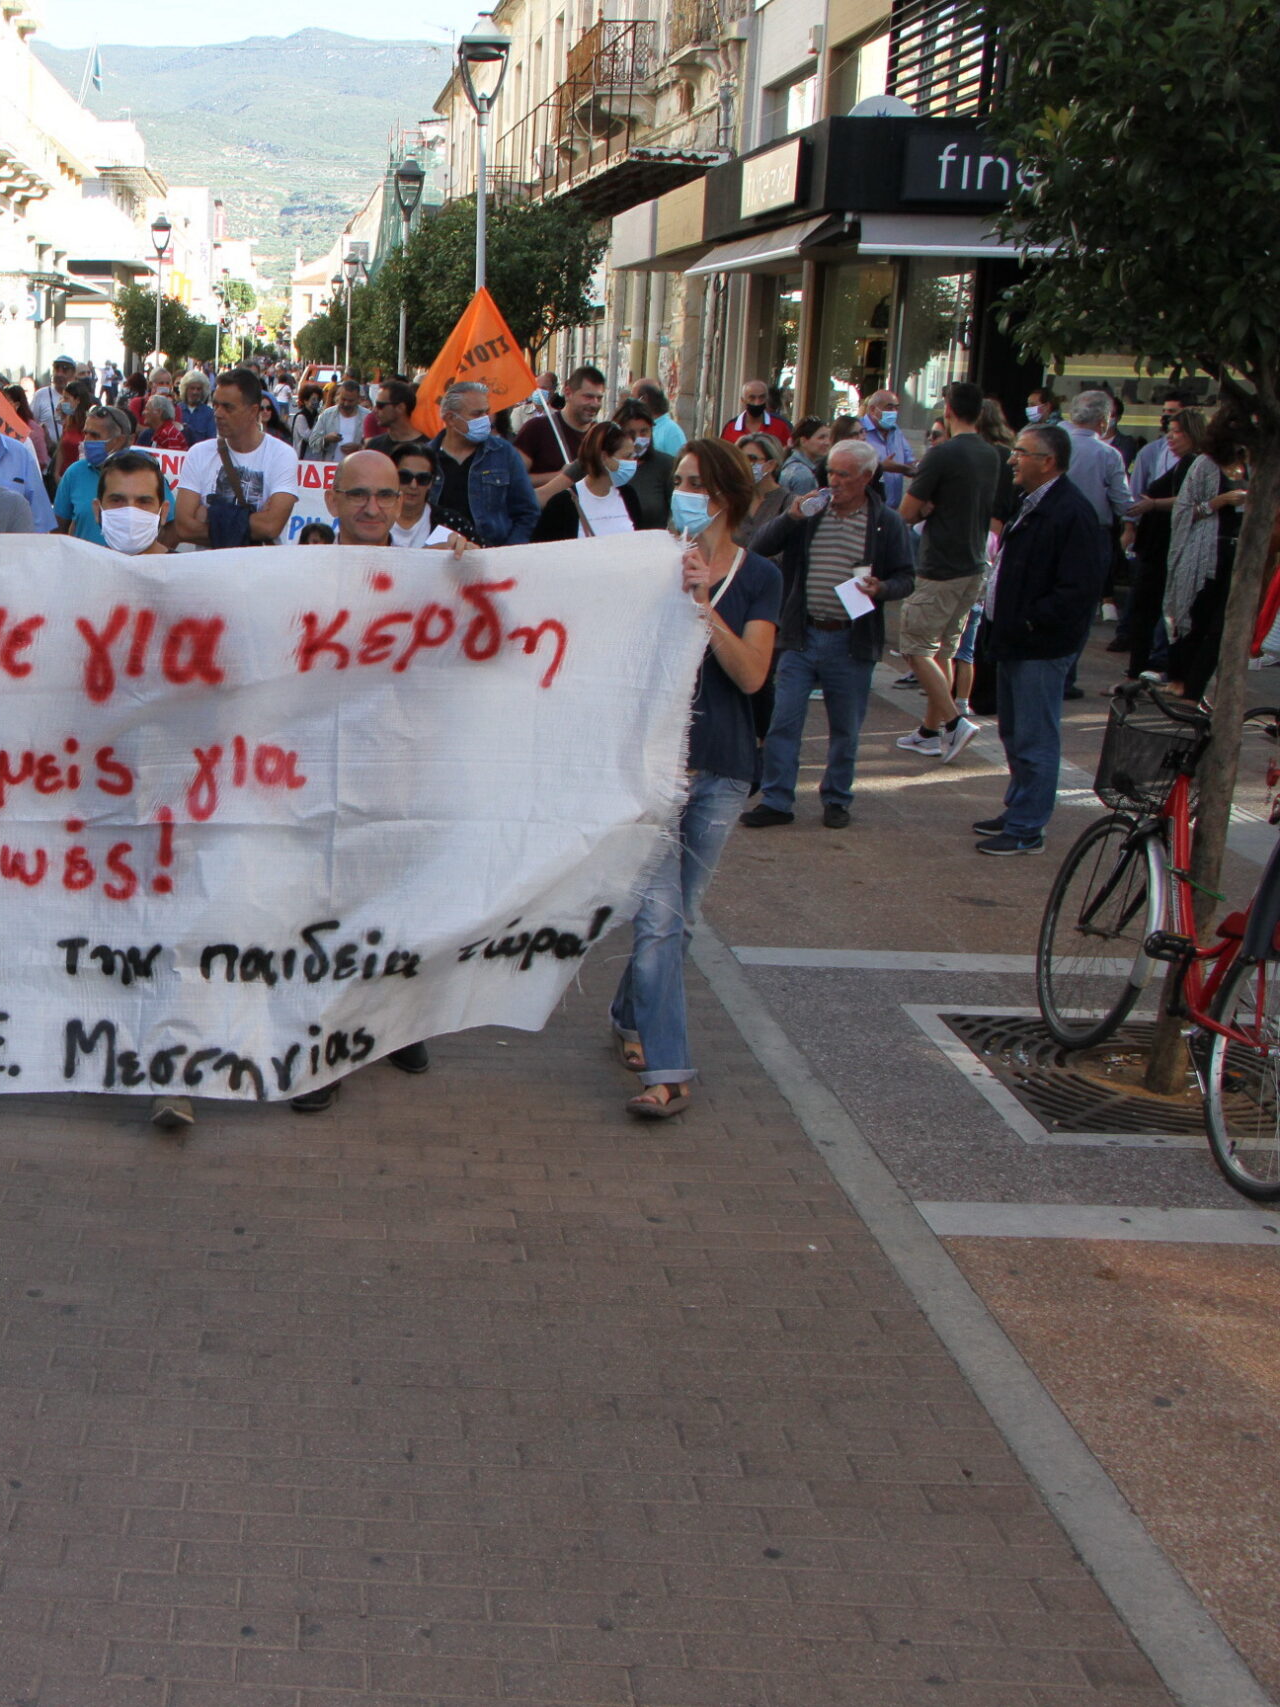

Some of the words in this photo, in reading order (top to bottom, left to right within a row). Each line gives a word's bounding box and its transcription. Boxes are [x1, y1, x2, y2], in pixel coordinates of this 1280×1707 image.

[76, 605, 225, 702] για
[297, 574, 567, 689] κέρδη
[187, 735, 307, 822] για
[57, 937, 162, 986] την
[62, 1021, 376, 1098] Μεσσηνίας
